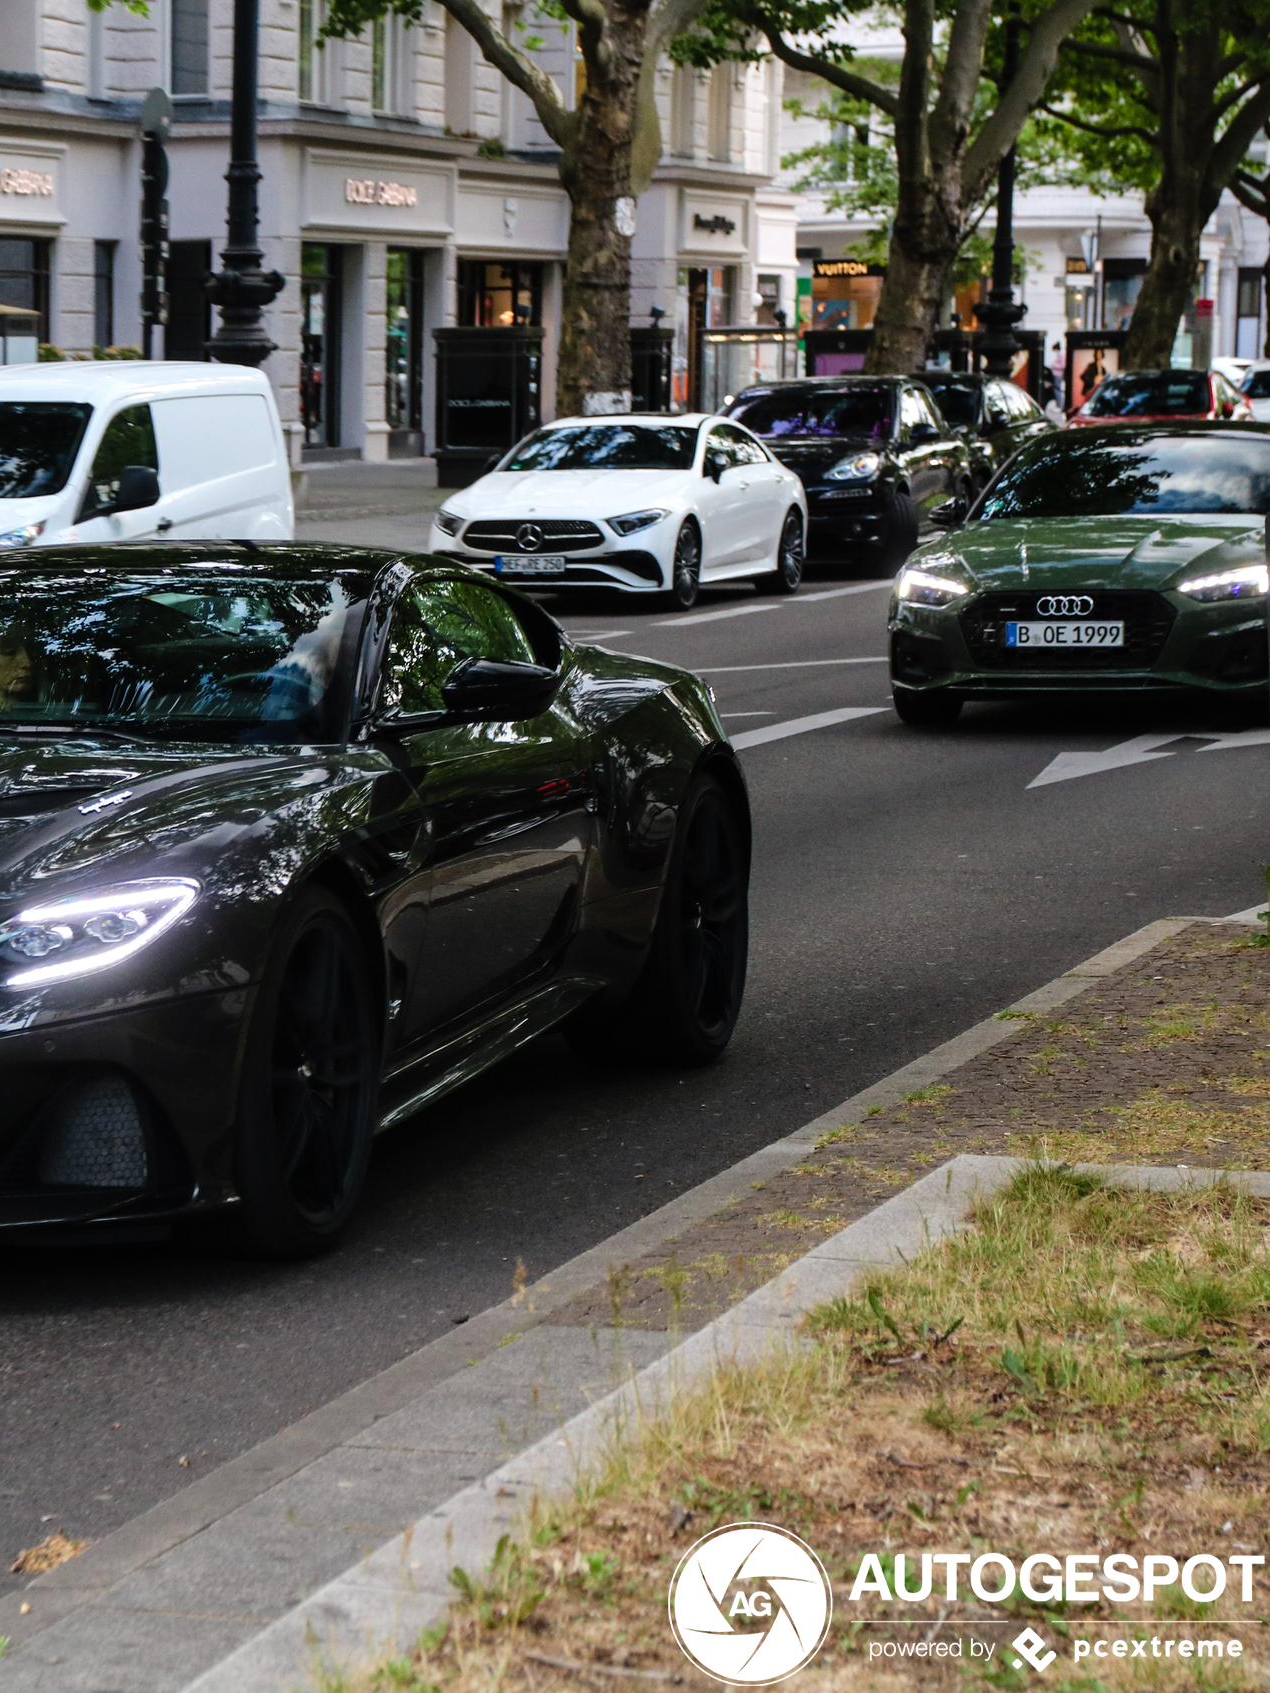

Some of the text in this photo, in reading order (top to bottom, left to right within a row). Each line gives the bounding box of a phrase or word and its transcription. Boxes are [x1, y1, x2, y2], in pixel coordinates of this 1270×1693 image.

[817, 262, 868, 276] VUITTON
[1018, 626, 1120, 643] B OE 1999
